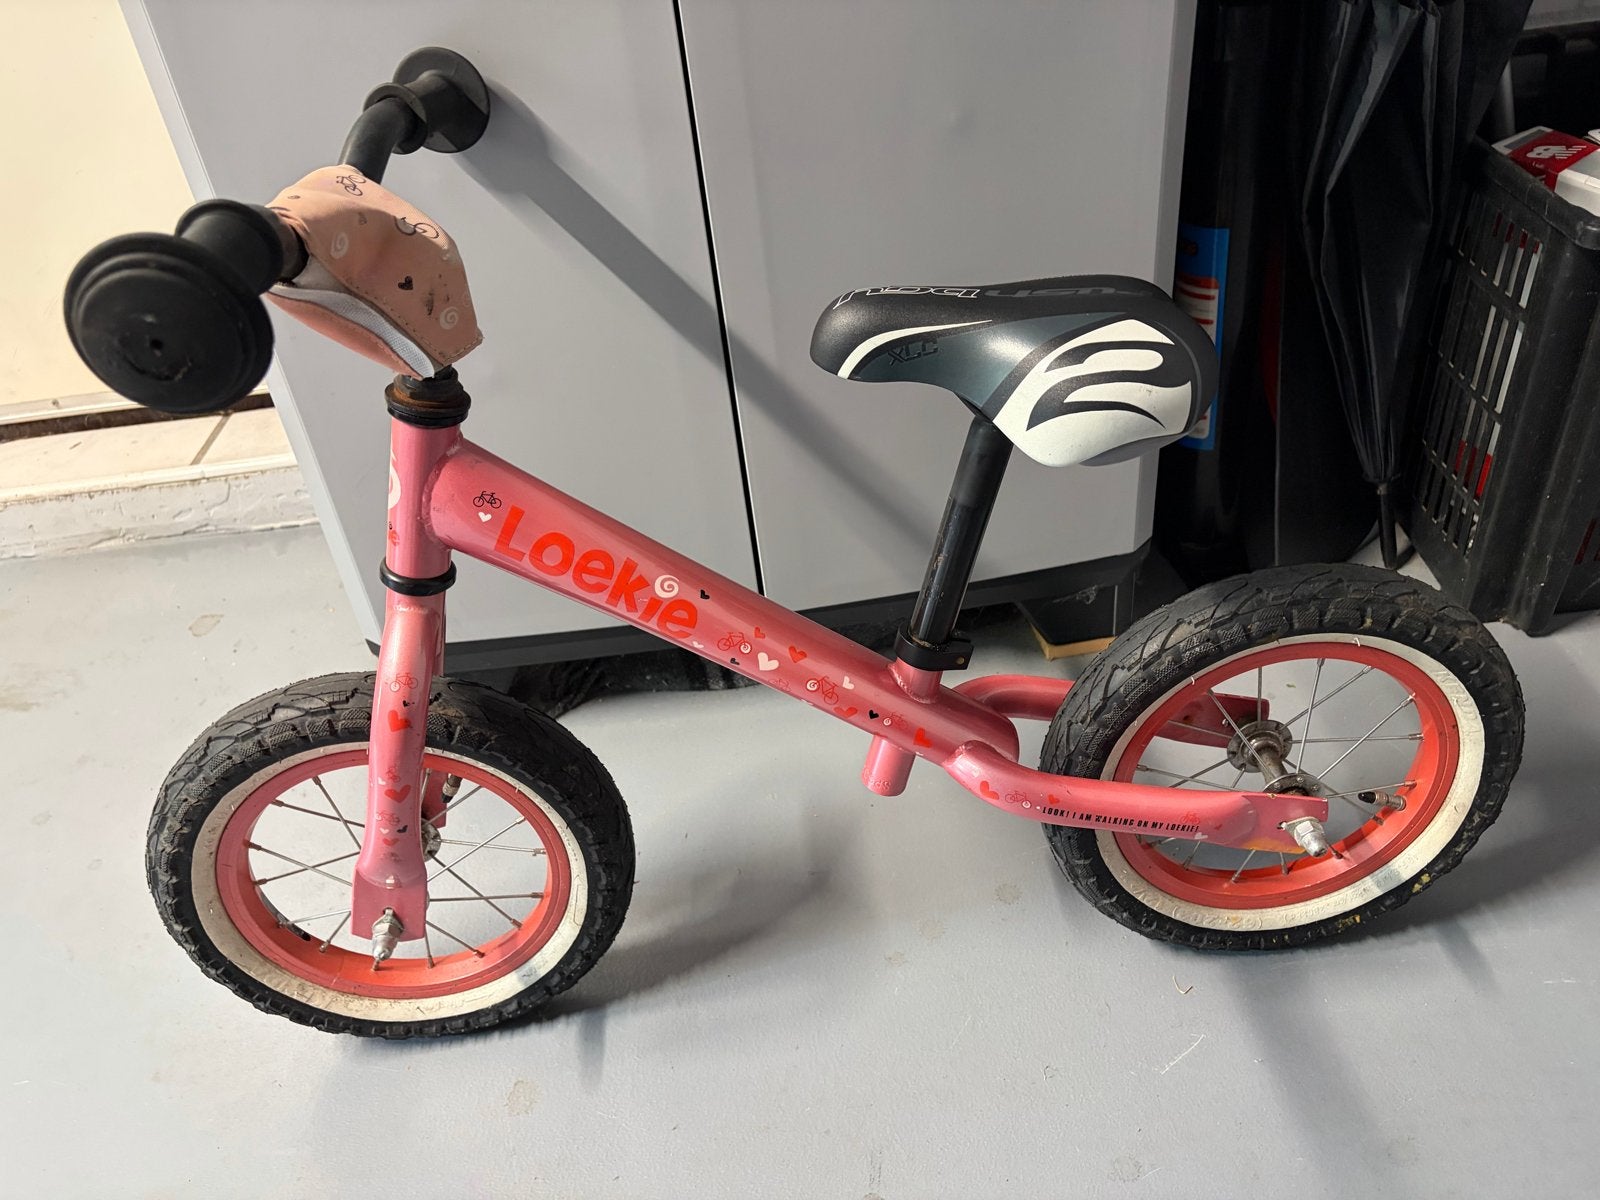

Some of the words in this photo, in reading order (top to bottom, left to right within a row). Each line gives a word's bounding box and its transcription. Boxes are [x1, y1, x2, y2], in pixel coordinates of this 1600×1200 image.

[494, 504, 698, 639] Loekie
[1042, 806, 1070, 818] LOOK!
[1079, 813, 1093, 821] AM
[1095, 814, 1135, 827] WALKING
[1137, 820, 1149, 828] ON
[1151, 821, 1164, 829] MY
